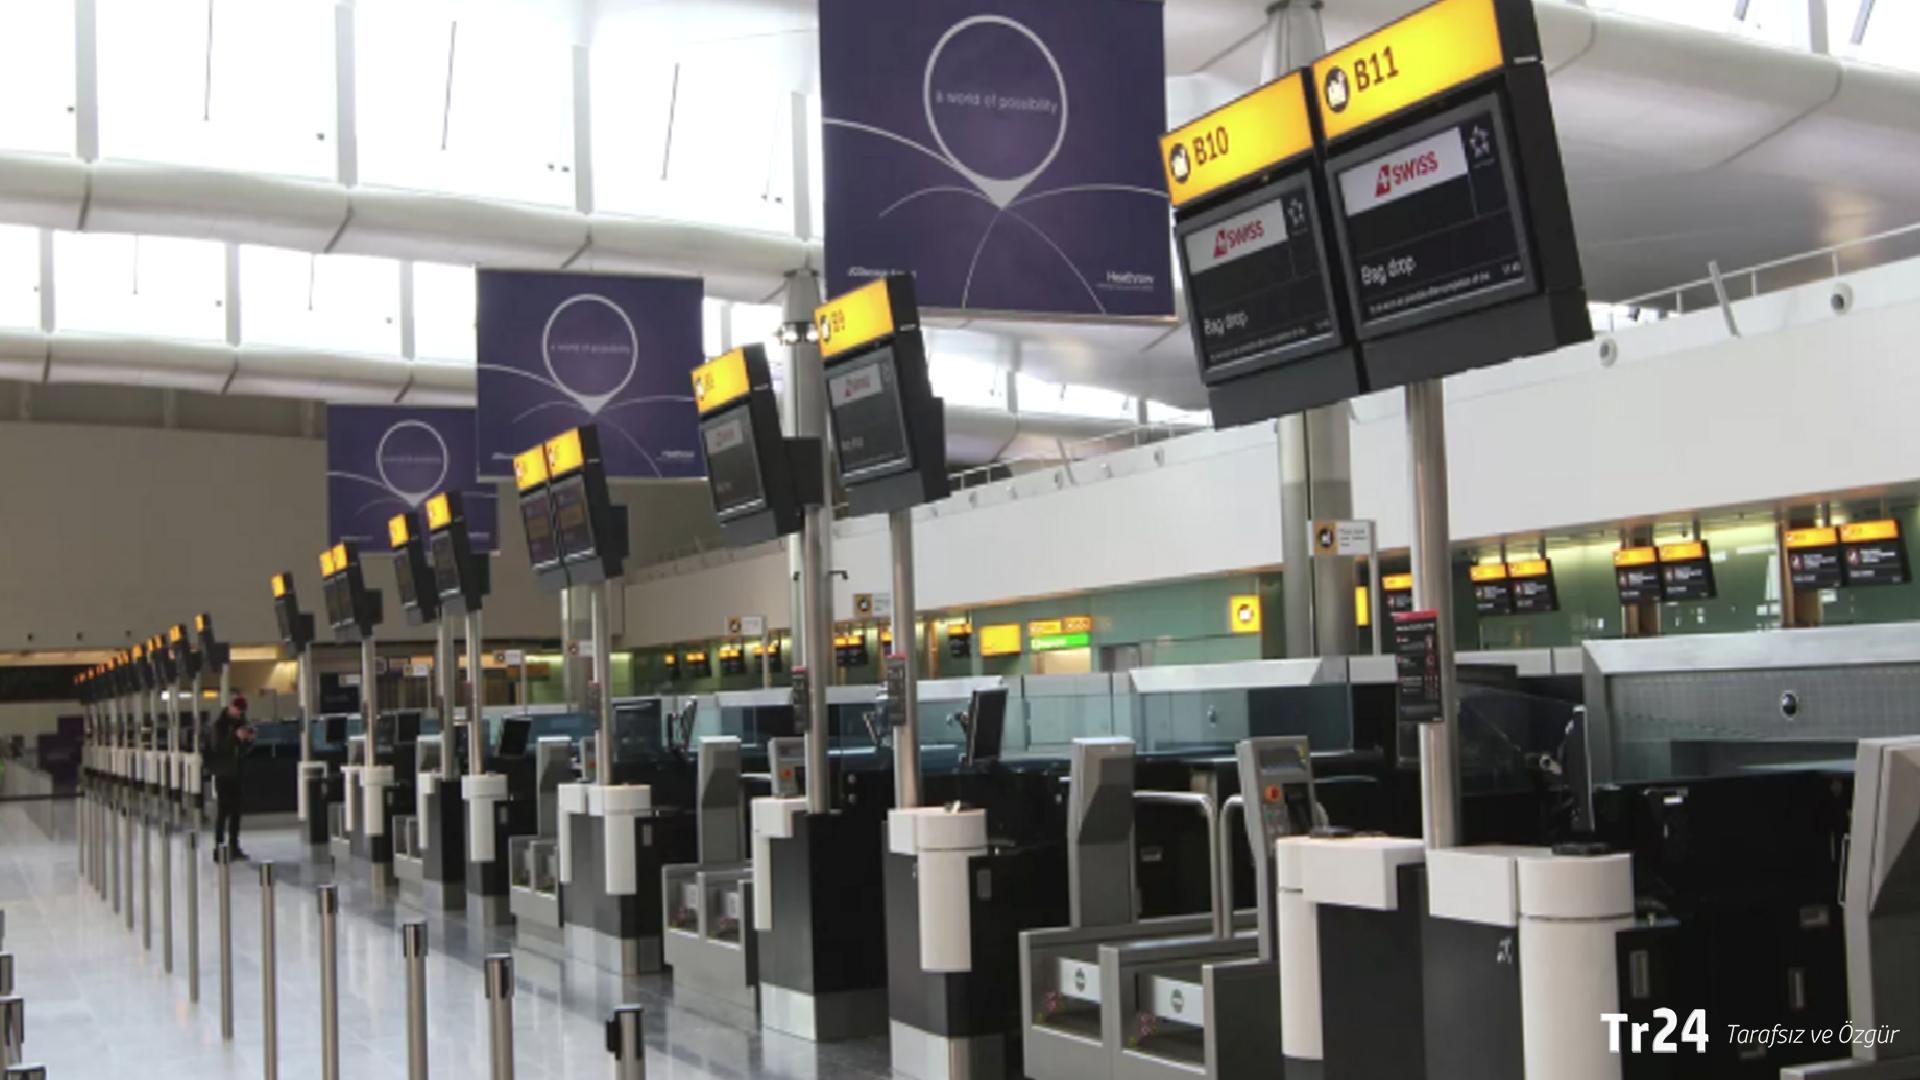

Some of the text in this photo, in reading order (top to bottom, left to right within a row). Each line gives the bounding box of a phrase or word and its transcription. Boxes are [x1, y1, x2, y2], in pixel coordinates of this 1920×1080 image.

[1354, 45, 1399, 93] B11
[946, 91, 980, 106] world
[983, 92, 997, 108] of
[998, 95, 1058, 116] possibility
[1192, 126, 1229, 166] B10
[1391, 150, 1438, 186] SWISS
[1226, 220, 1265, 249] SWISS
[1105, 269, 1154, 285] Heathrow
[1361, 264, 1387, 287] Bag
